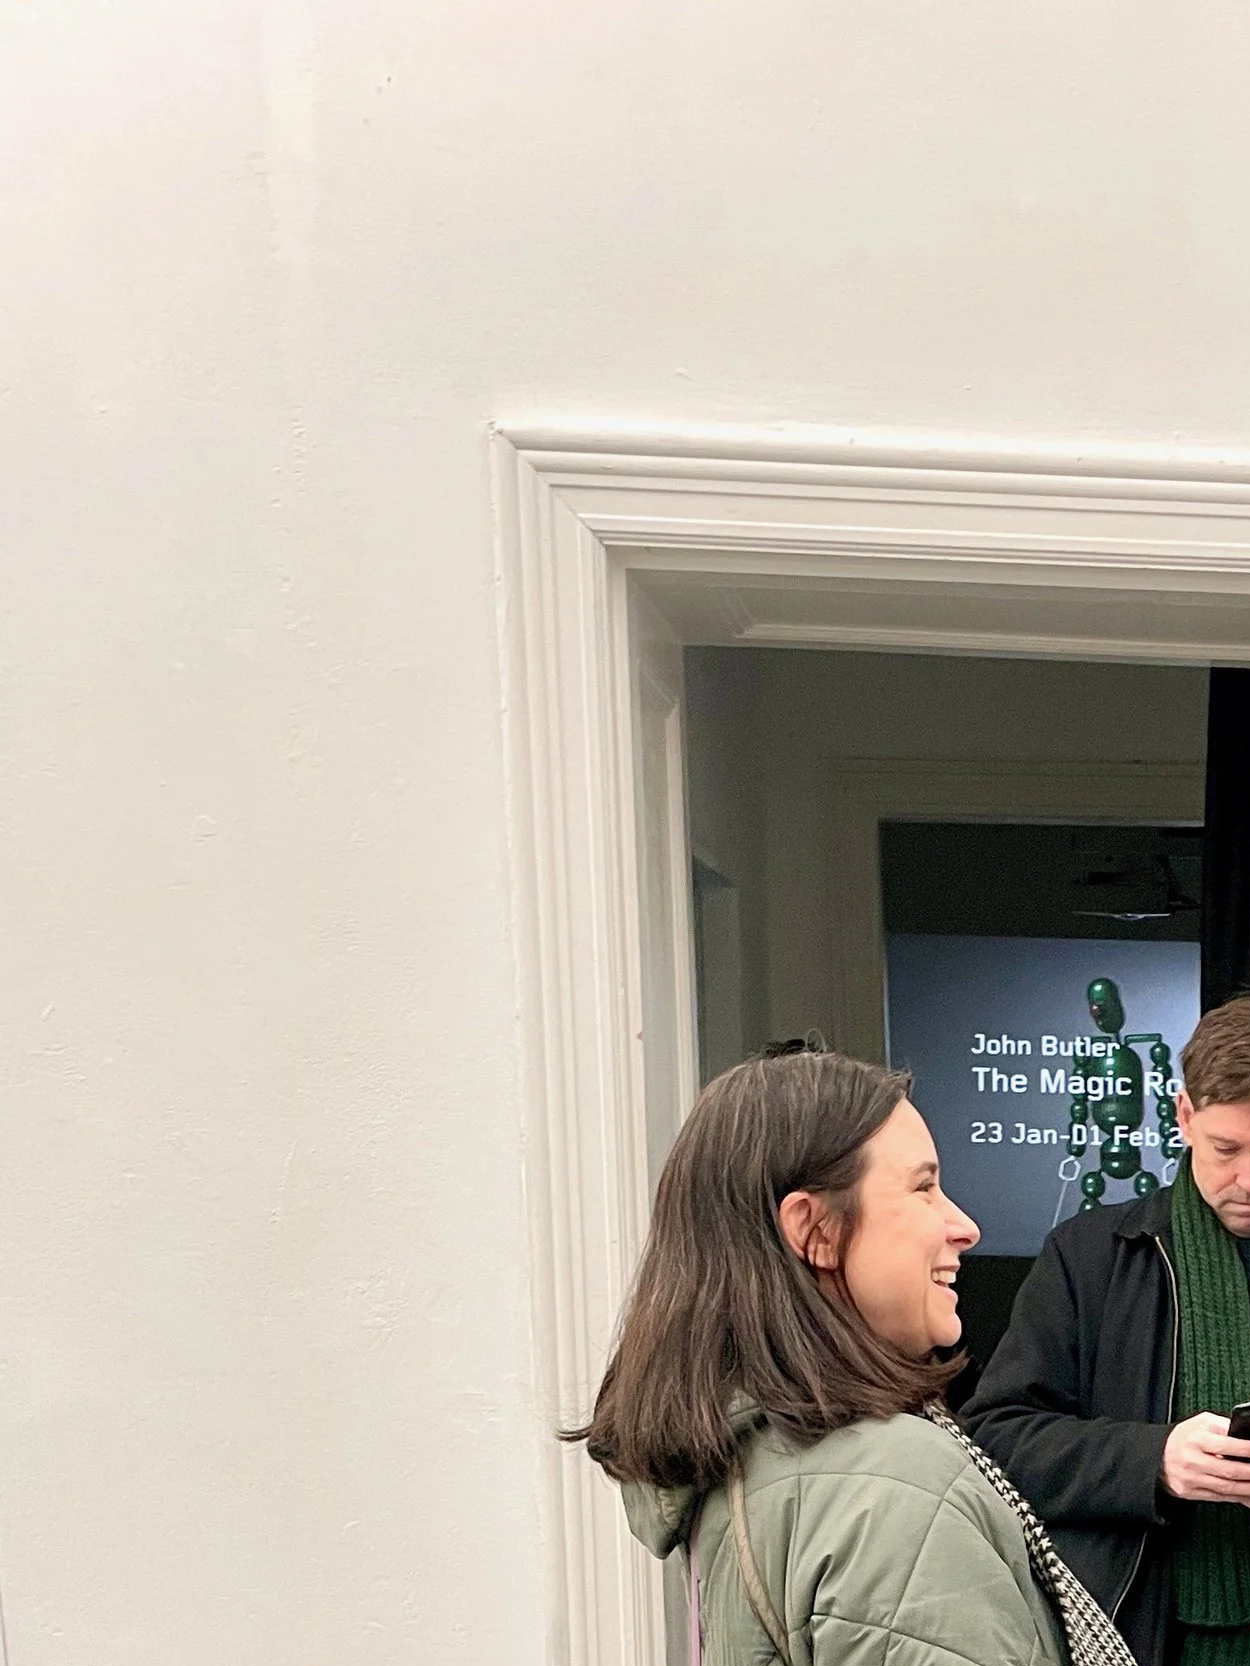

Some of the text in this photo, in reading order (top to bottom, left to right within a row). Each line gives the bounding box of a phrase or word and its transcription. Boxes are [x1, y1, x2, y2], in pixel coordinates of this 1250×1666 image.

[970, 1033, 1121, 1058] John Butler
[971, 1066, 1028, 1094] The
[1040, 1068, 1133, 1101] Magic
[970, 1121, 1003, 1143] 23
[1113, 1125, 1160, 1147] Feb
